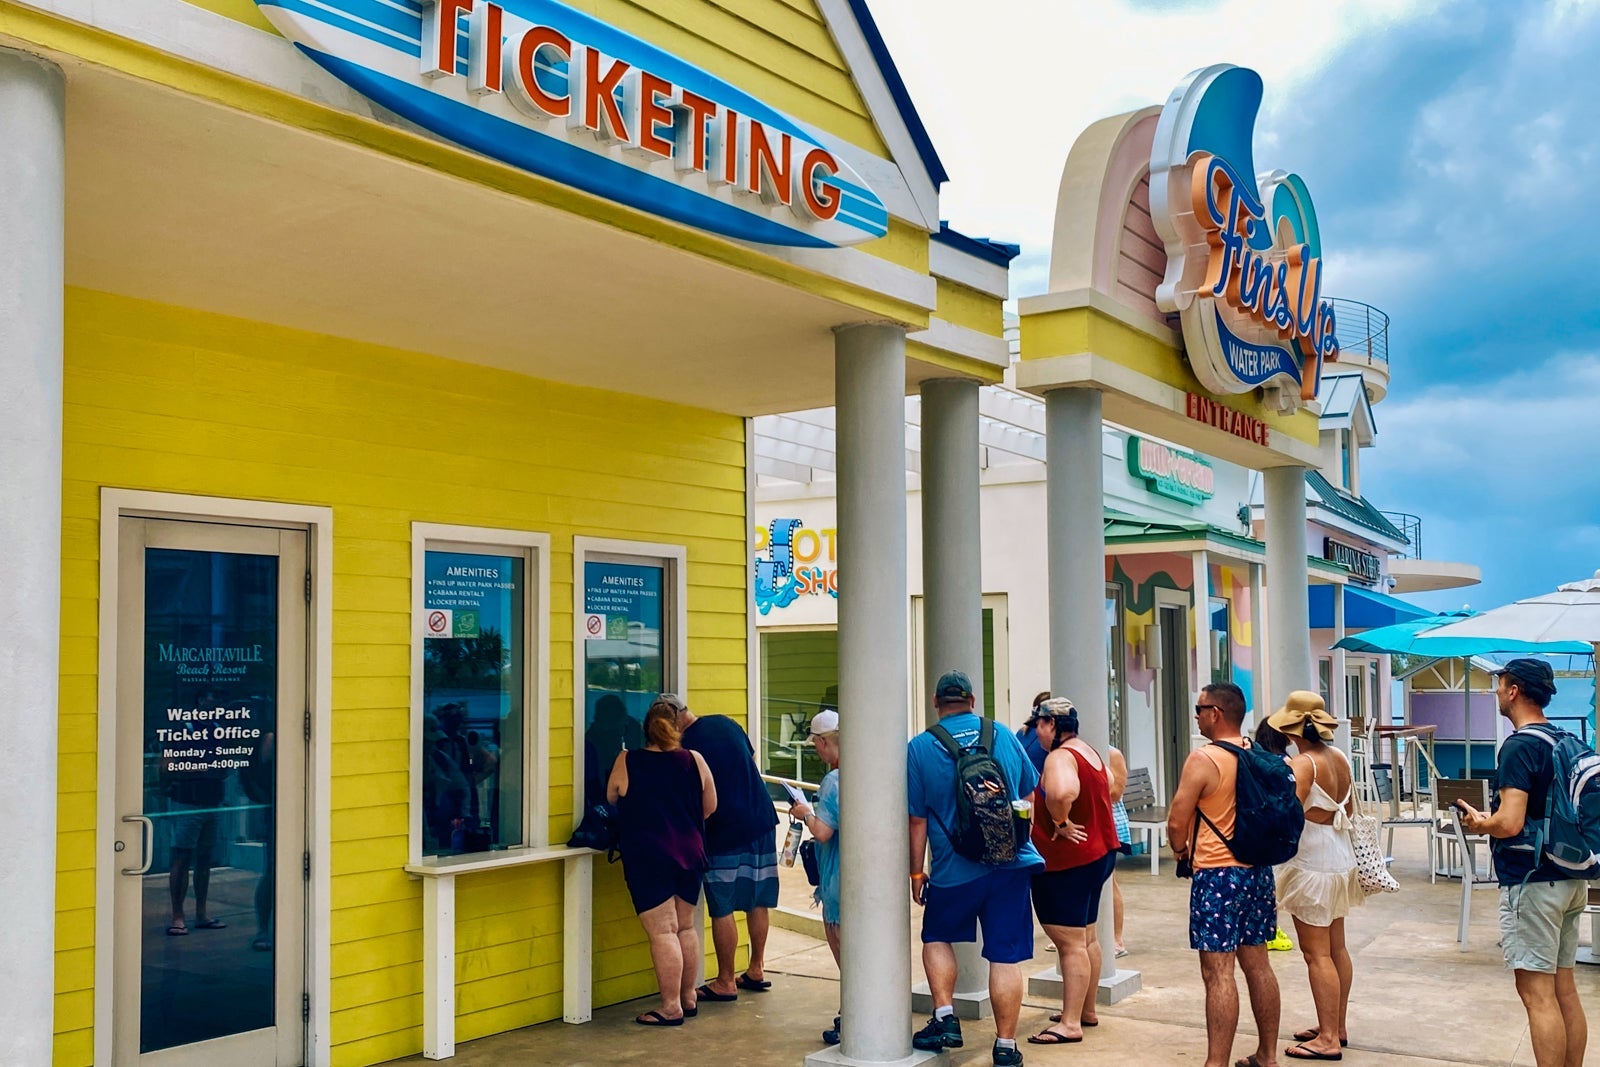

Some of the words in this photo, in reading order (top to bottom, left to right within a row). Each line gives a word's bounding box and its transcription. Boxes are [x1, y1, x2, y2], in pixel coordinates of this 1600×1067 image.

[424, 0, 842, 221] TICKETING
[1204, 155, 1296, 339] Fins
[1297, 243, 1340, 400] Up
[1229, 340, 1259, 376] WATER
[1260, 351, 1282, 375] PARK
[1186, 392, 1270, 447] ENTRANCE
[446, 566, 499, 578] AMENITIES
[602, 576, 644, 587] AMENITIES
[458, 590, 485, 598] RENTALS
[159, 643, 264, 662] MARGARITAVILLE
[176, 663, 210, 675] Beach
[212, 663, 247, 675] Resort
[167, 707, 251, 721] WaterPark
[156, 728, 209, 742] Ticket
[213, 726, 261, 739] Office
[163, 748, 206, 758] Monday
[215, 746, 254, 756] Sunday
[168, 760, 250, 771] 8:00am-4:00pm
